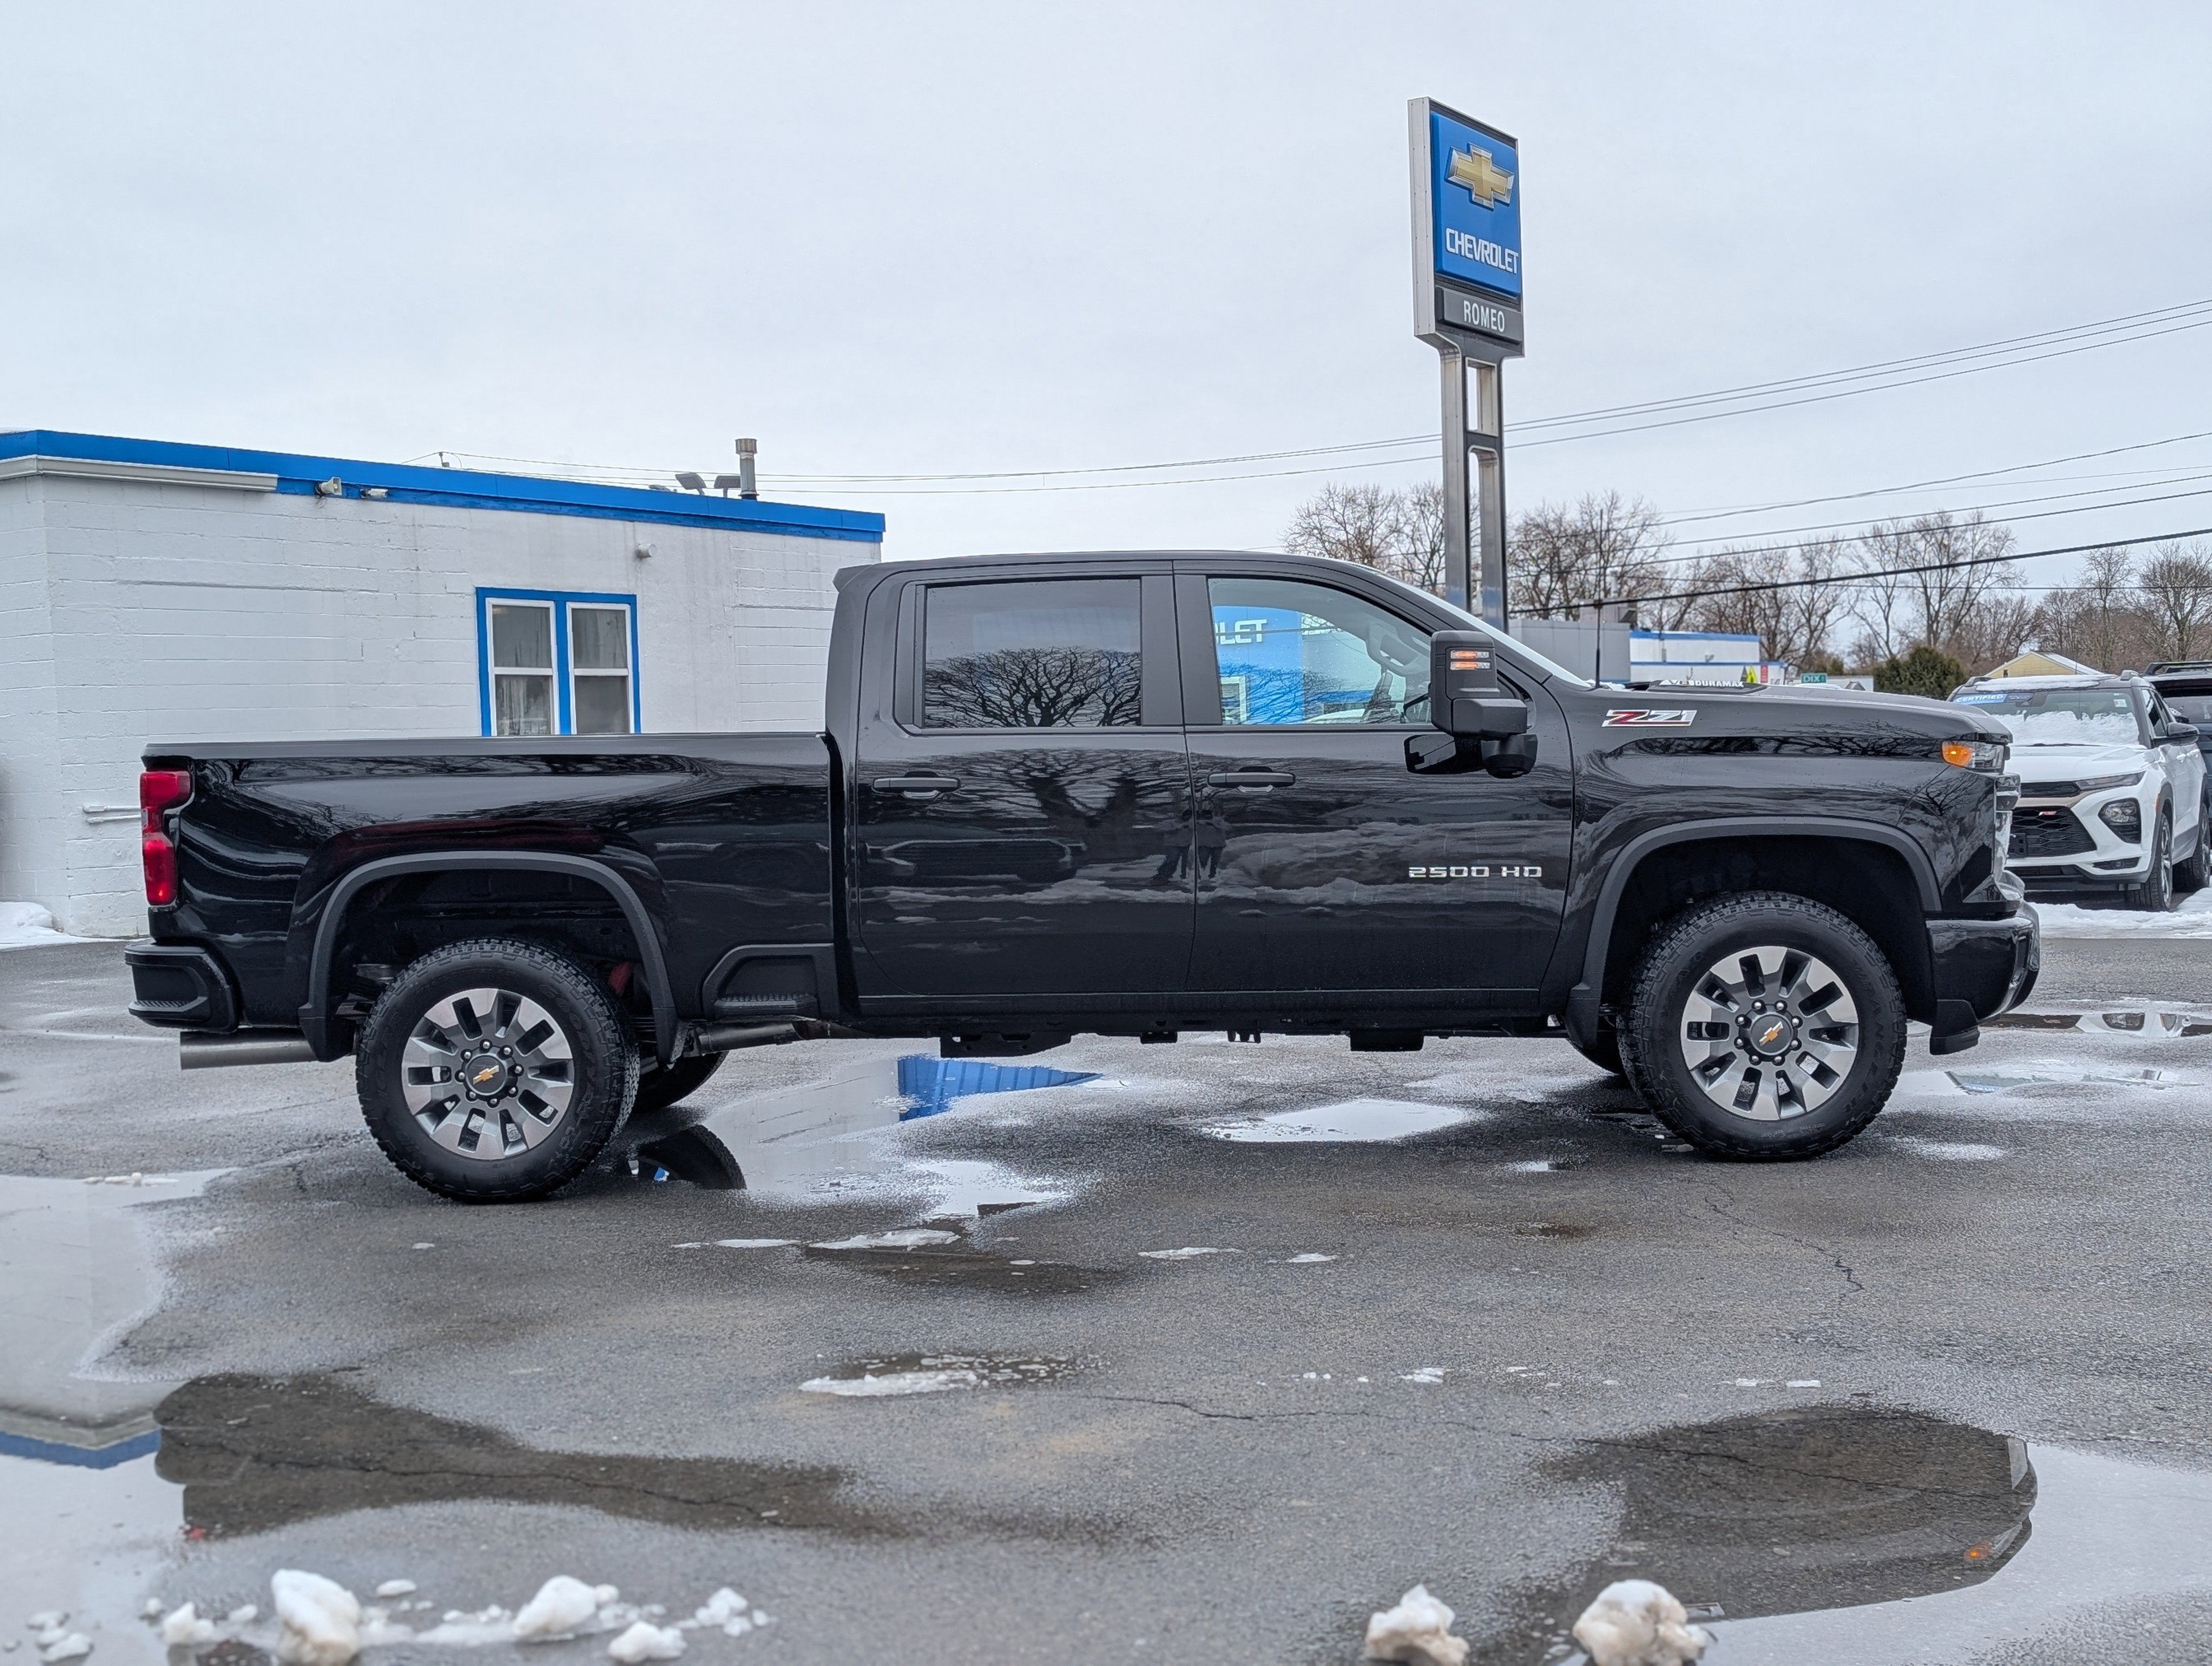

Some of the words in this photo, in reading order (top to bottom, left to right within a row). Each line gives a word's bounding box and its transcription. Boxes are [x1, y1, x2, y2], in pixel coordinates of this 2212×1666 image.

[1446, 228, 1519, 273] CHEVROLET
[1463, 300, 1505, 332] ROMEO
[1956, 695, 2004, 703] CERTIFIED
[1601, 709, 1697, 727] Z71
[1409, 867, 1489, 877] 2500
[1501, 867, 1542, 877] HD
